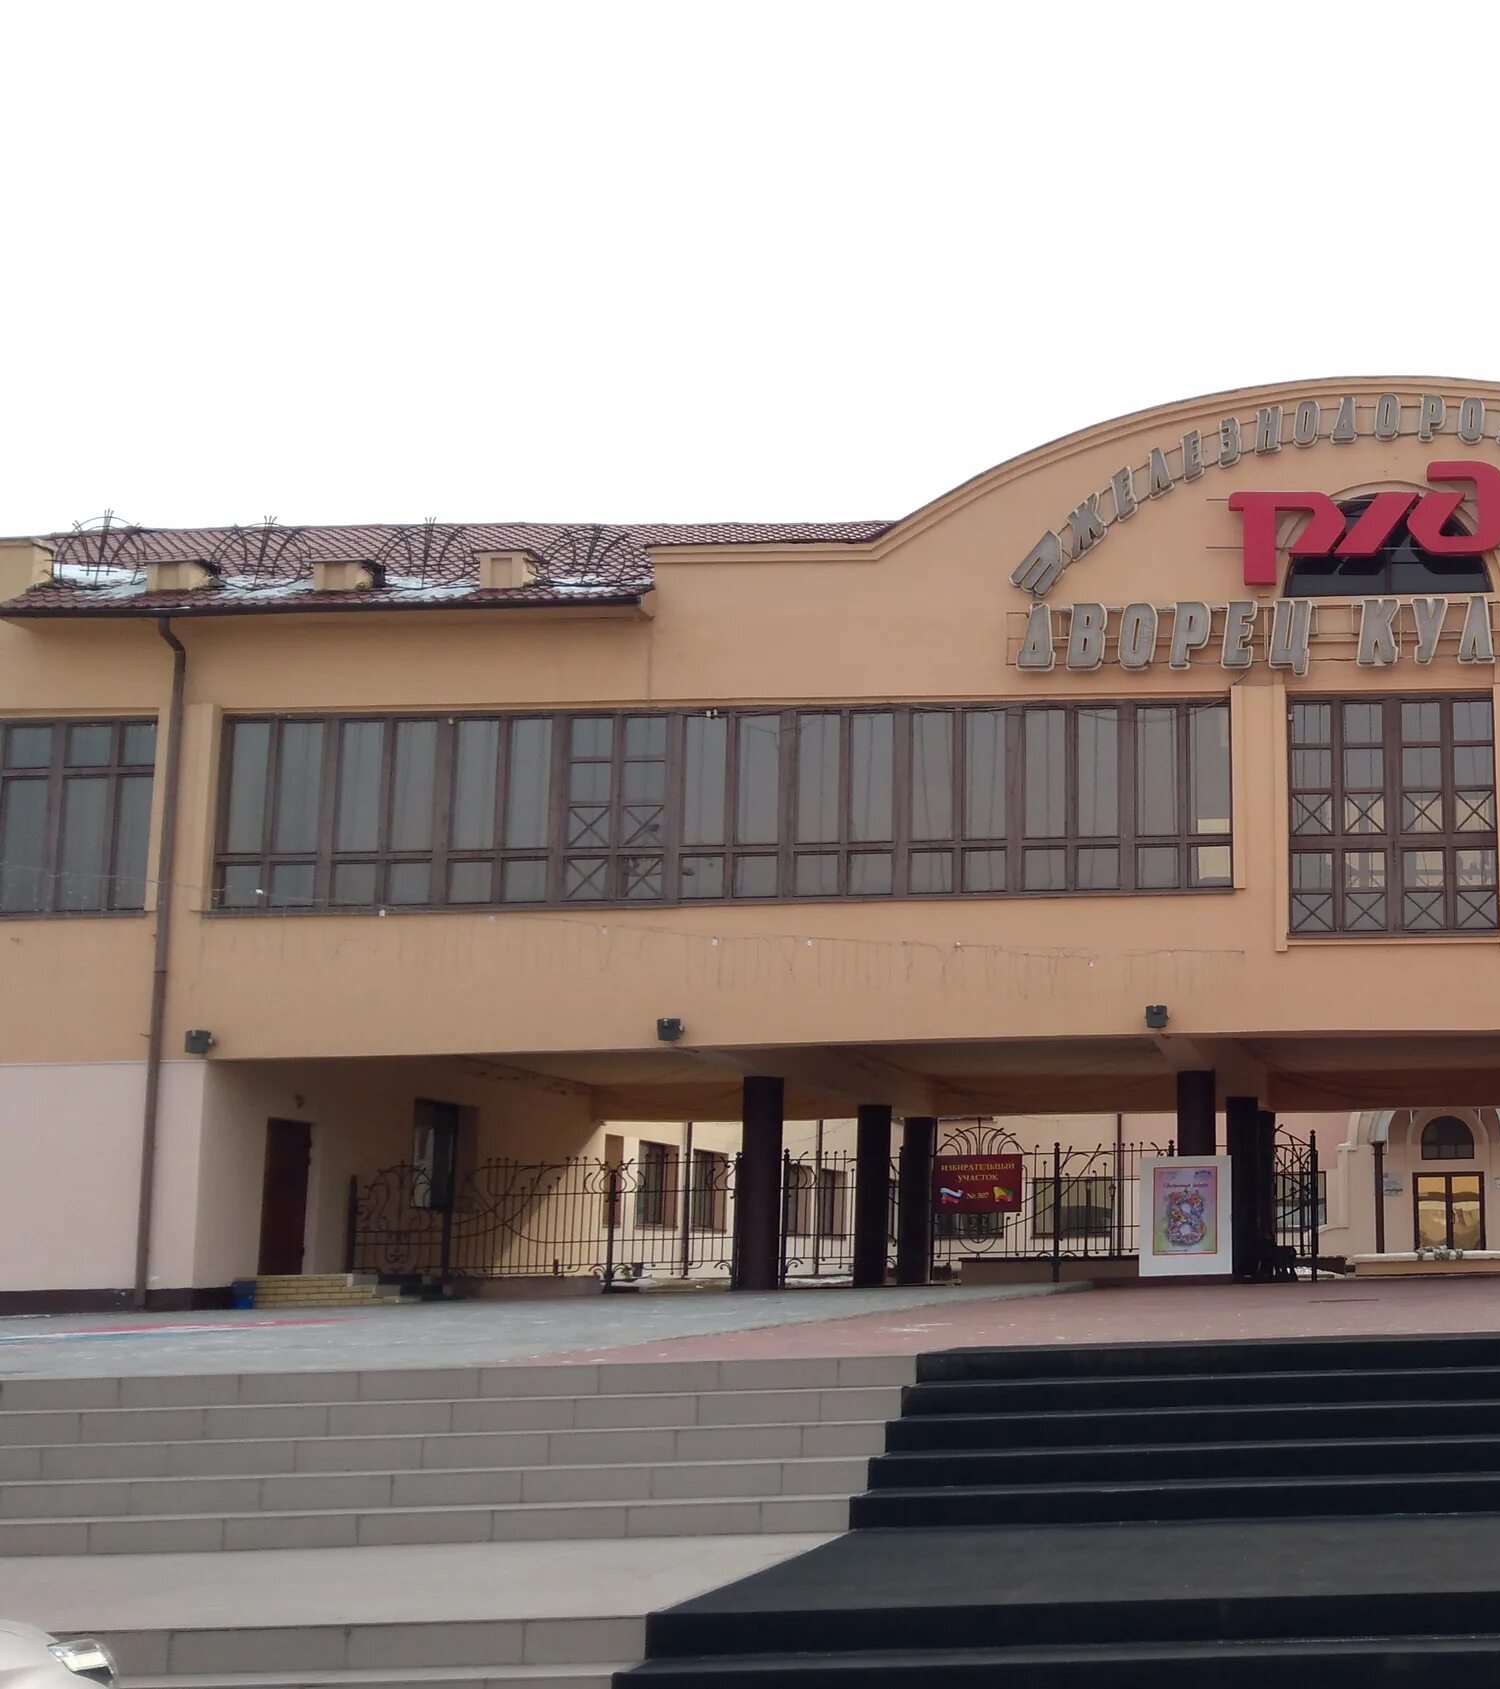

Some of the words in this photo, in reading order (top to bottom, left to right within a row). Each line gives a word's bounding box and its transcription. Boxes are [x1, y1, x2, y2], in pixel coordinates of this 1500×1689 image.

[1015, 601, 1311, 677] ДВОРЕЦ
[941, 1163, 1015, 1171] ИЗБИРАТЕЛЬНЫЙ
[958, 1174, 998, 1183] УЧАСТОК
